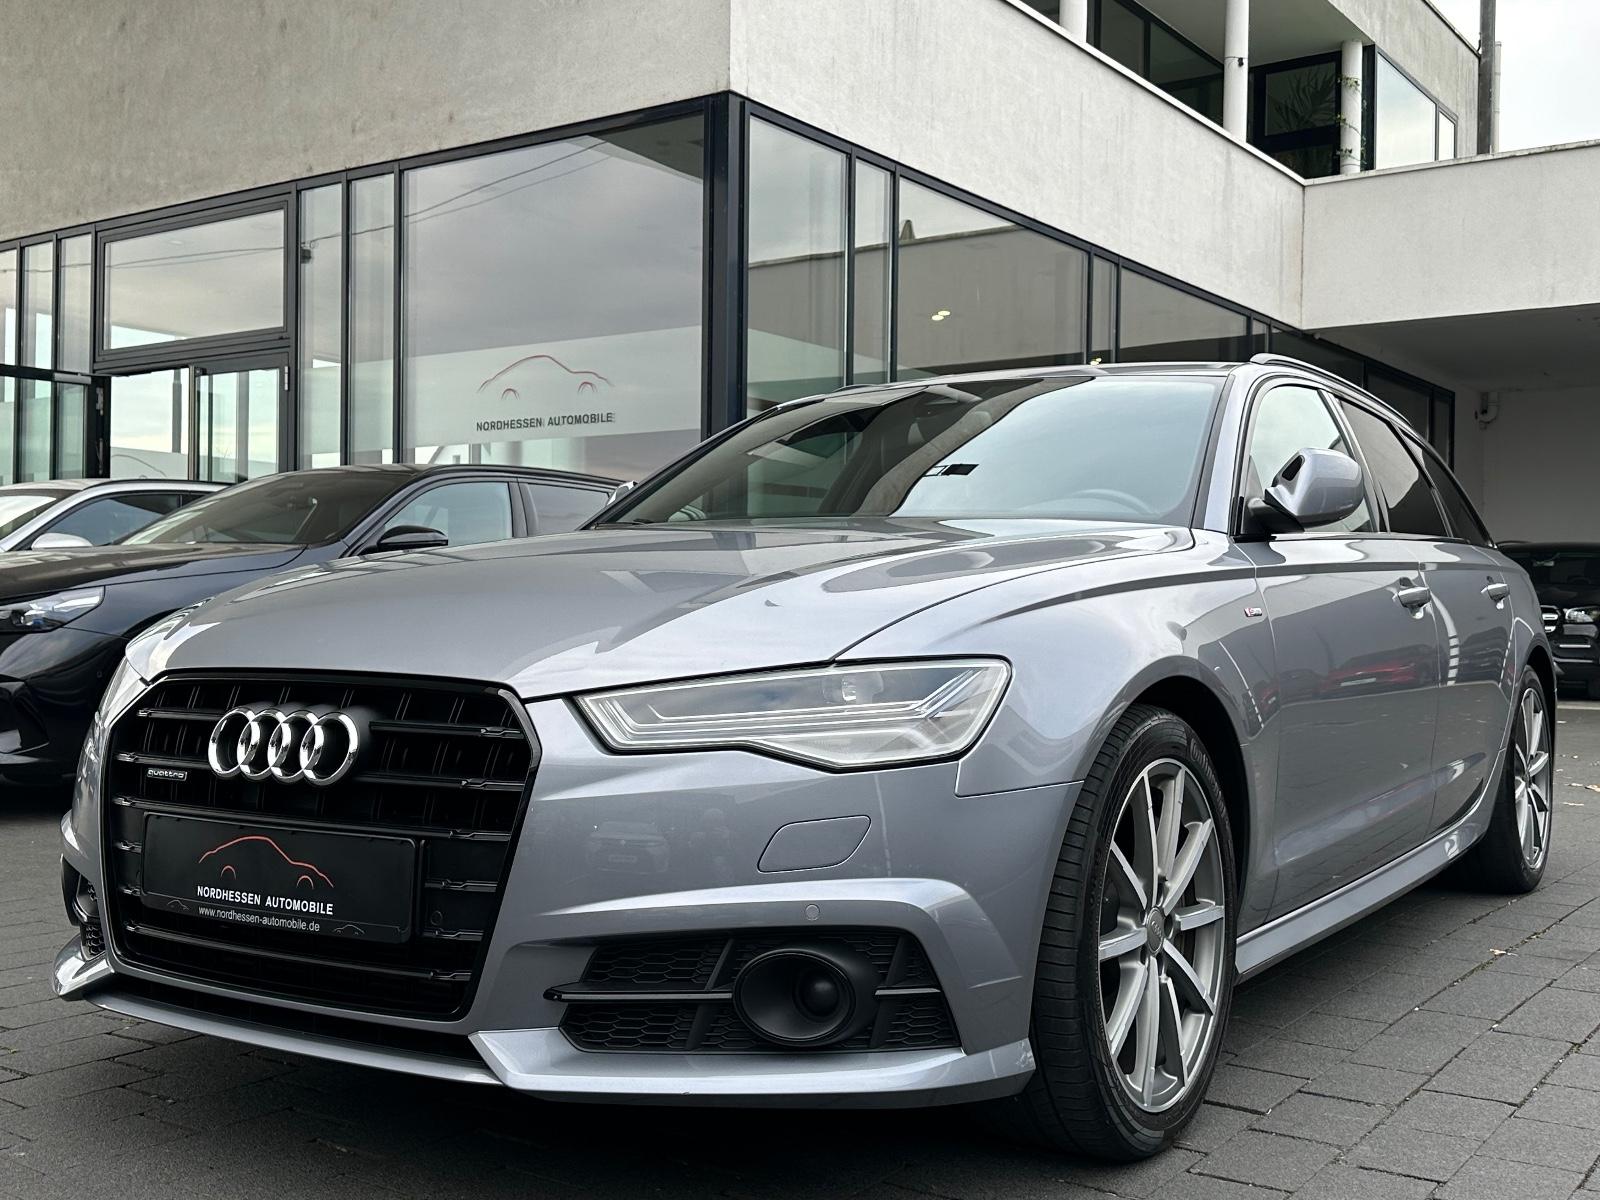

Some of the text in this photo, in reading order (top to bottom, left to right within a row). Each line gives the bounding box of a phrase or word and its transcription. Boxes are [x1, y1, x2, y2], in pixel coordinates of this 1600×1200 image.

[476, 412, 613, 431] NORDHESSEN AUTOMOBILE
[147, 769, 185, 779] quattro
[197, 885, 334, 915] NORDHESSEN AUTOMOBILE
[198, 906, 320, 932] www.nordhessen-automobile.de
